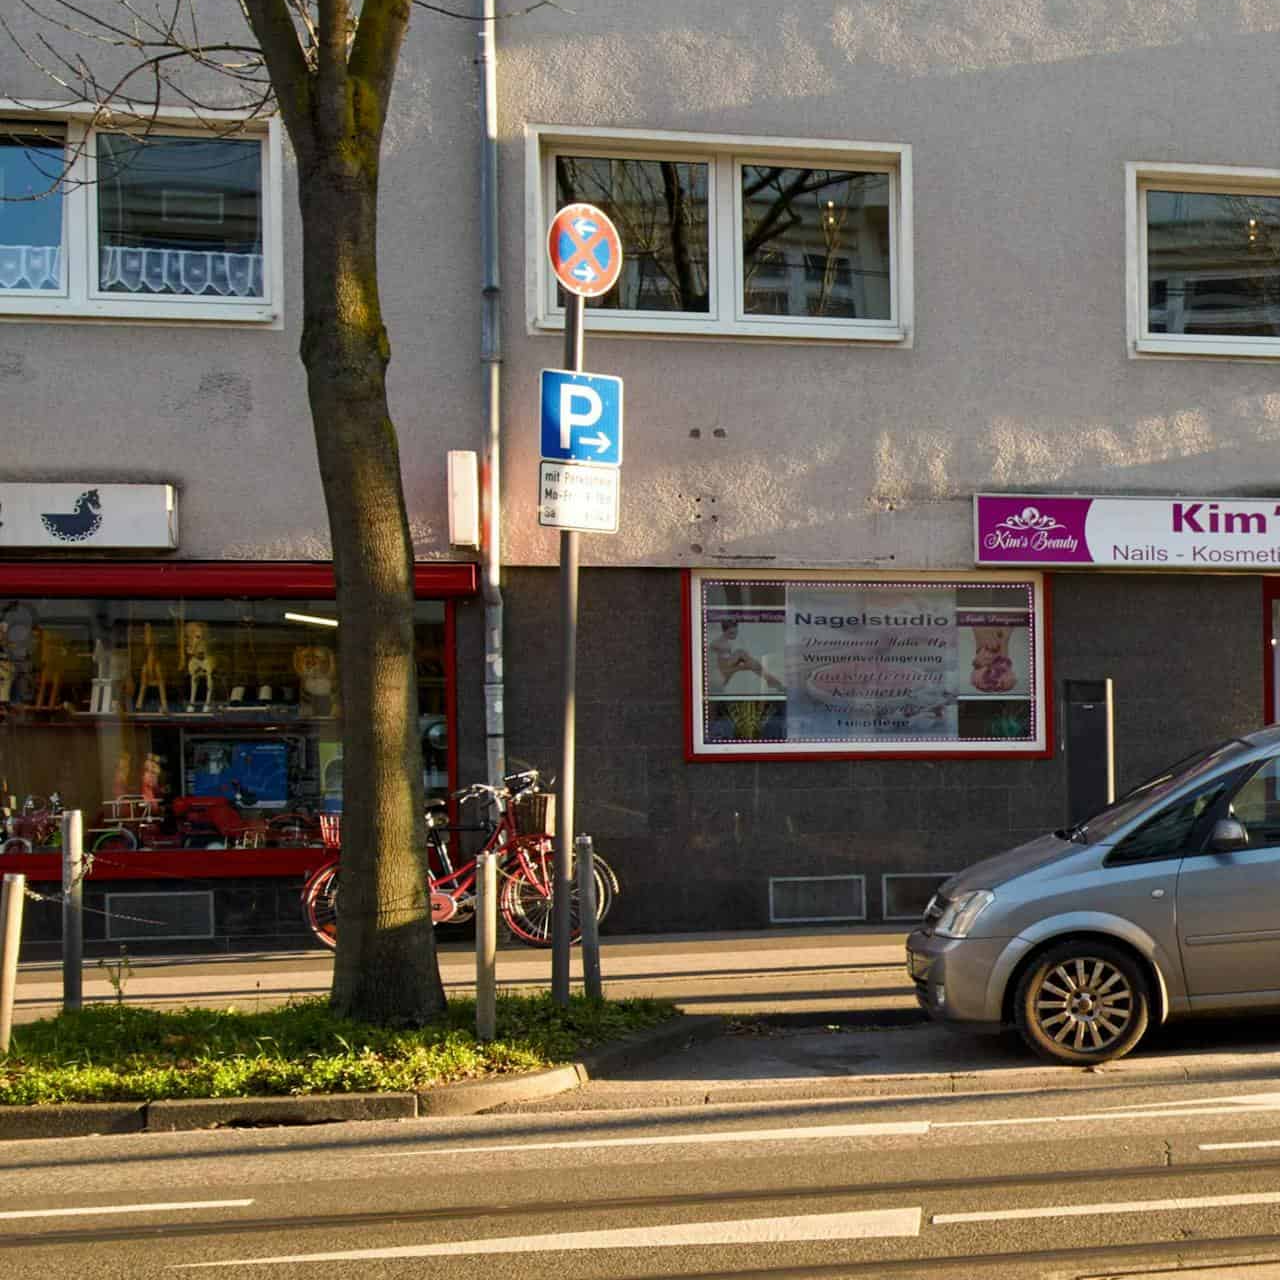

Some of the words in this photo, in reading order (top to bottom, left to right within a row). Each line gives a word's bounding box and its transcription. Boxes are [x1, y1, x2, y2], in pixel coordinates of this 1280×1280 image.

[560, 383, 602, 449] P
[545, 471, 560, 483] mit
[544, 505, 556, 518] Sa
[983, 529, 1030, 551] Kim's
[1031, 530, 1079, 553] Beauty
[1112, 544, 1168, 562] Nails
[794, 612, 950, 629] Nagelstudio
